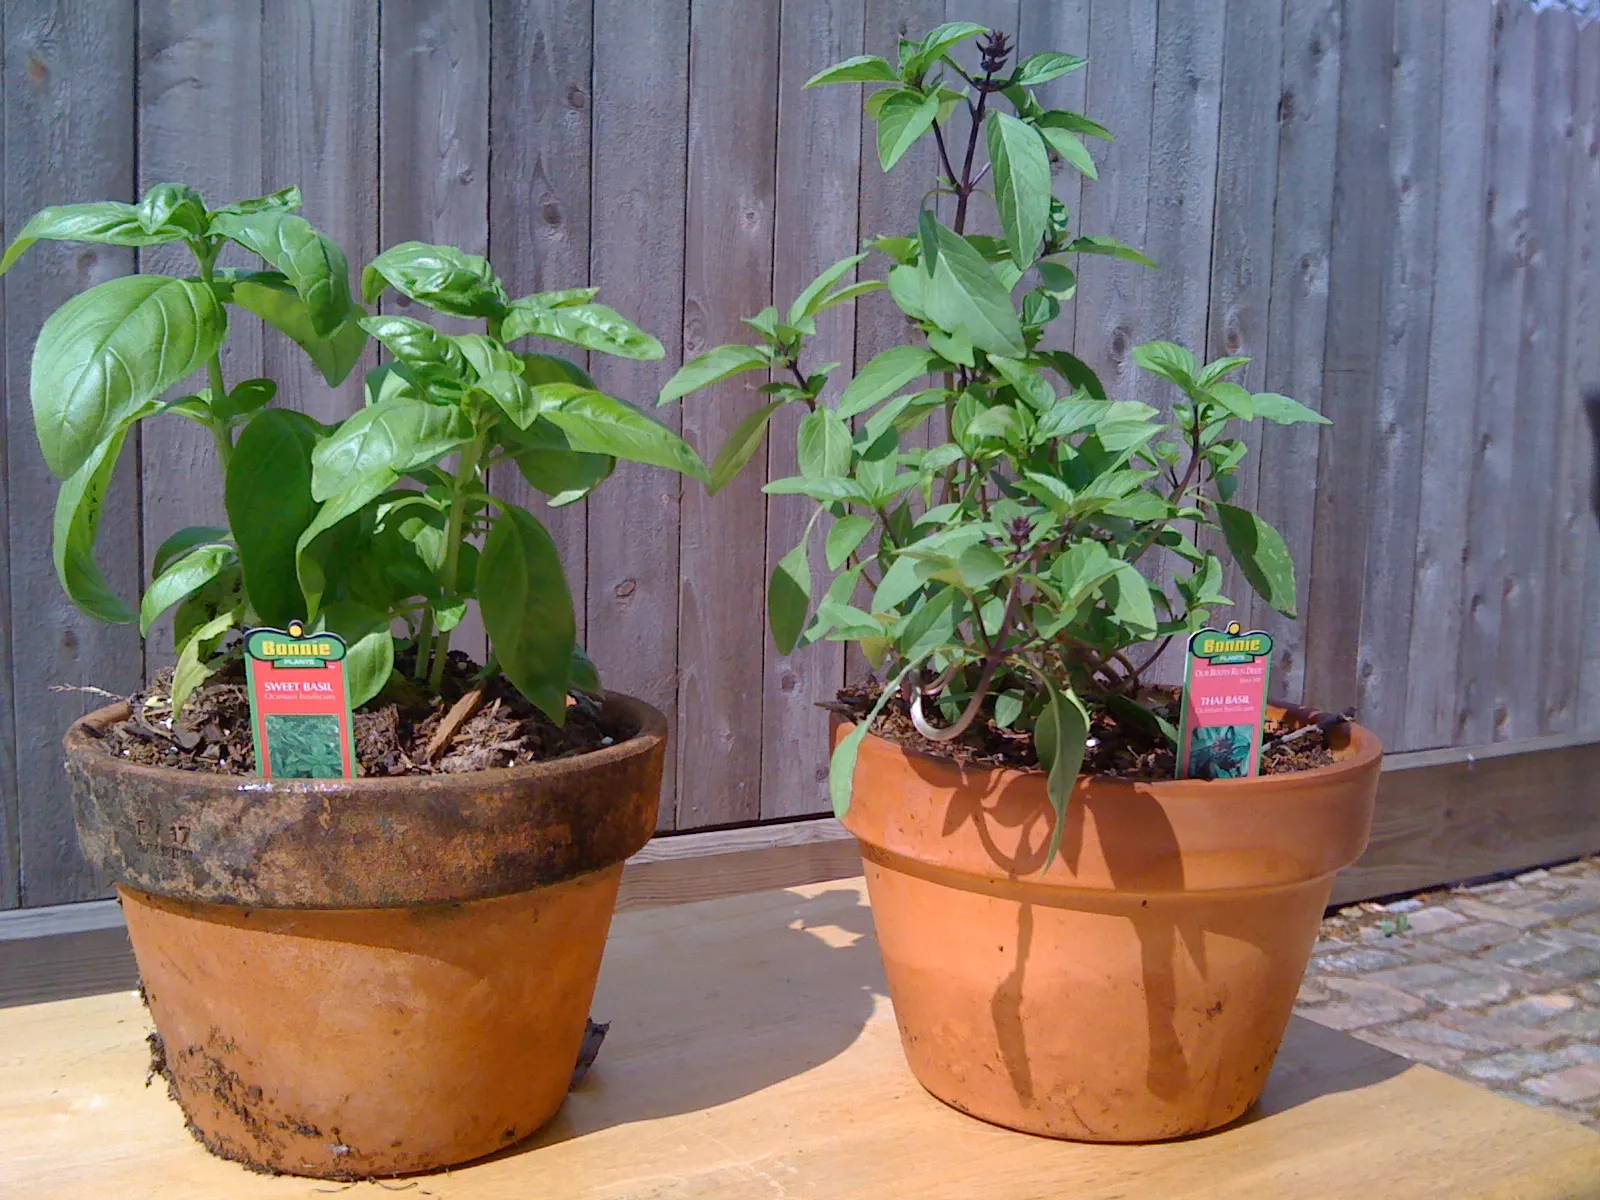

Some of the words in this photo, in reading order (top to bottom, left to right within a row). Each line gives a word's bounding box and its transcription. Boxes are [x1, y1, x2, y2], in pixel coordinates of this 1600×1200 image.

[262, 640, 331, 655] Bonnie
[1204, 639, 1260, 653] Bonnie
[264, 681, 300, 692] SWEET
[303, 681, 334, 692] BASIL
[1200, 696, 1224, 706] THAI
[1225, 695, 1250, 705] BASIL
